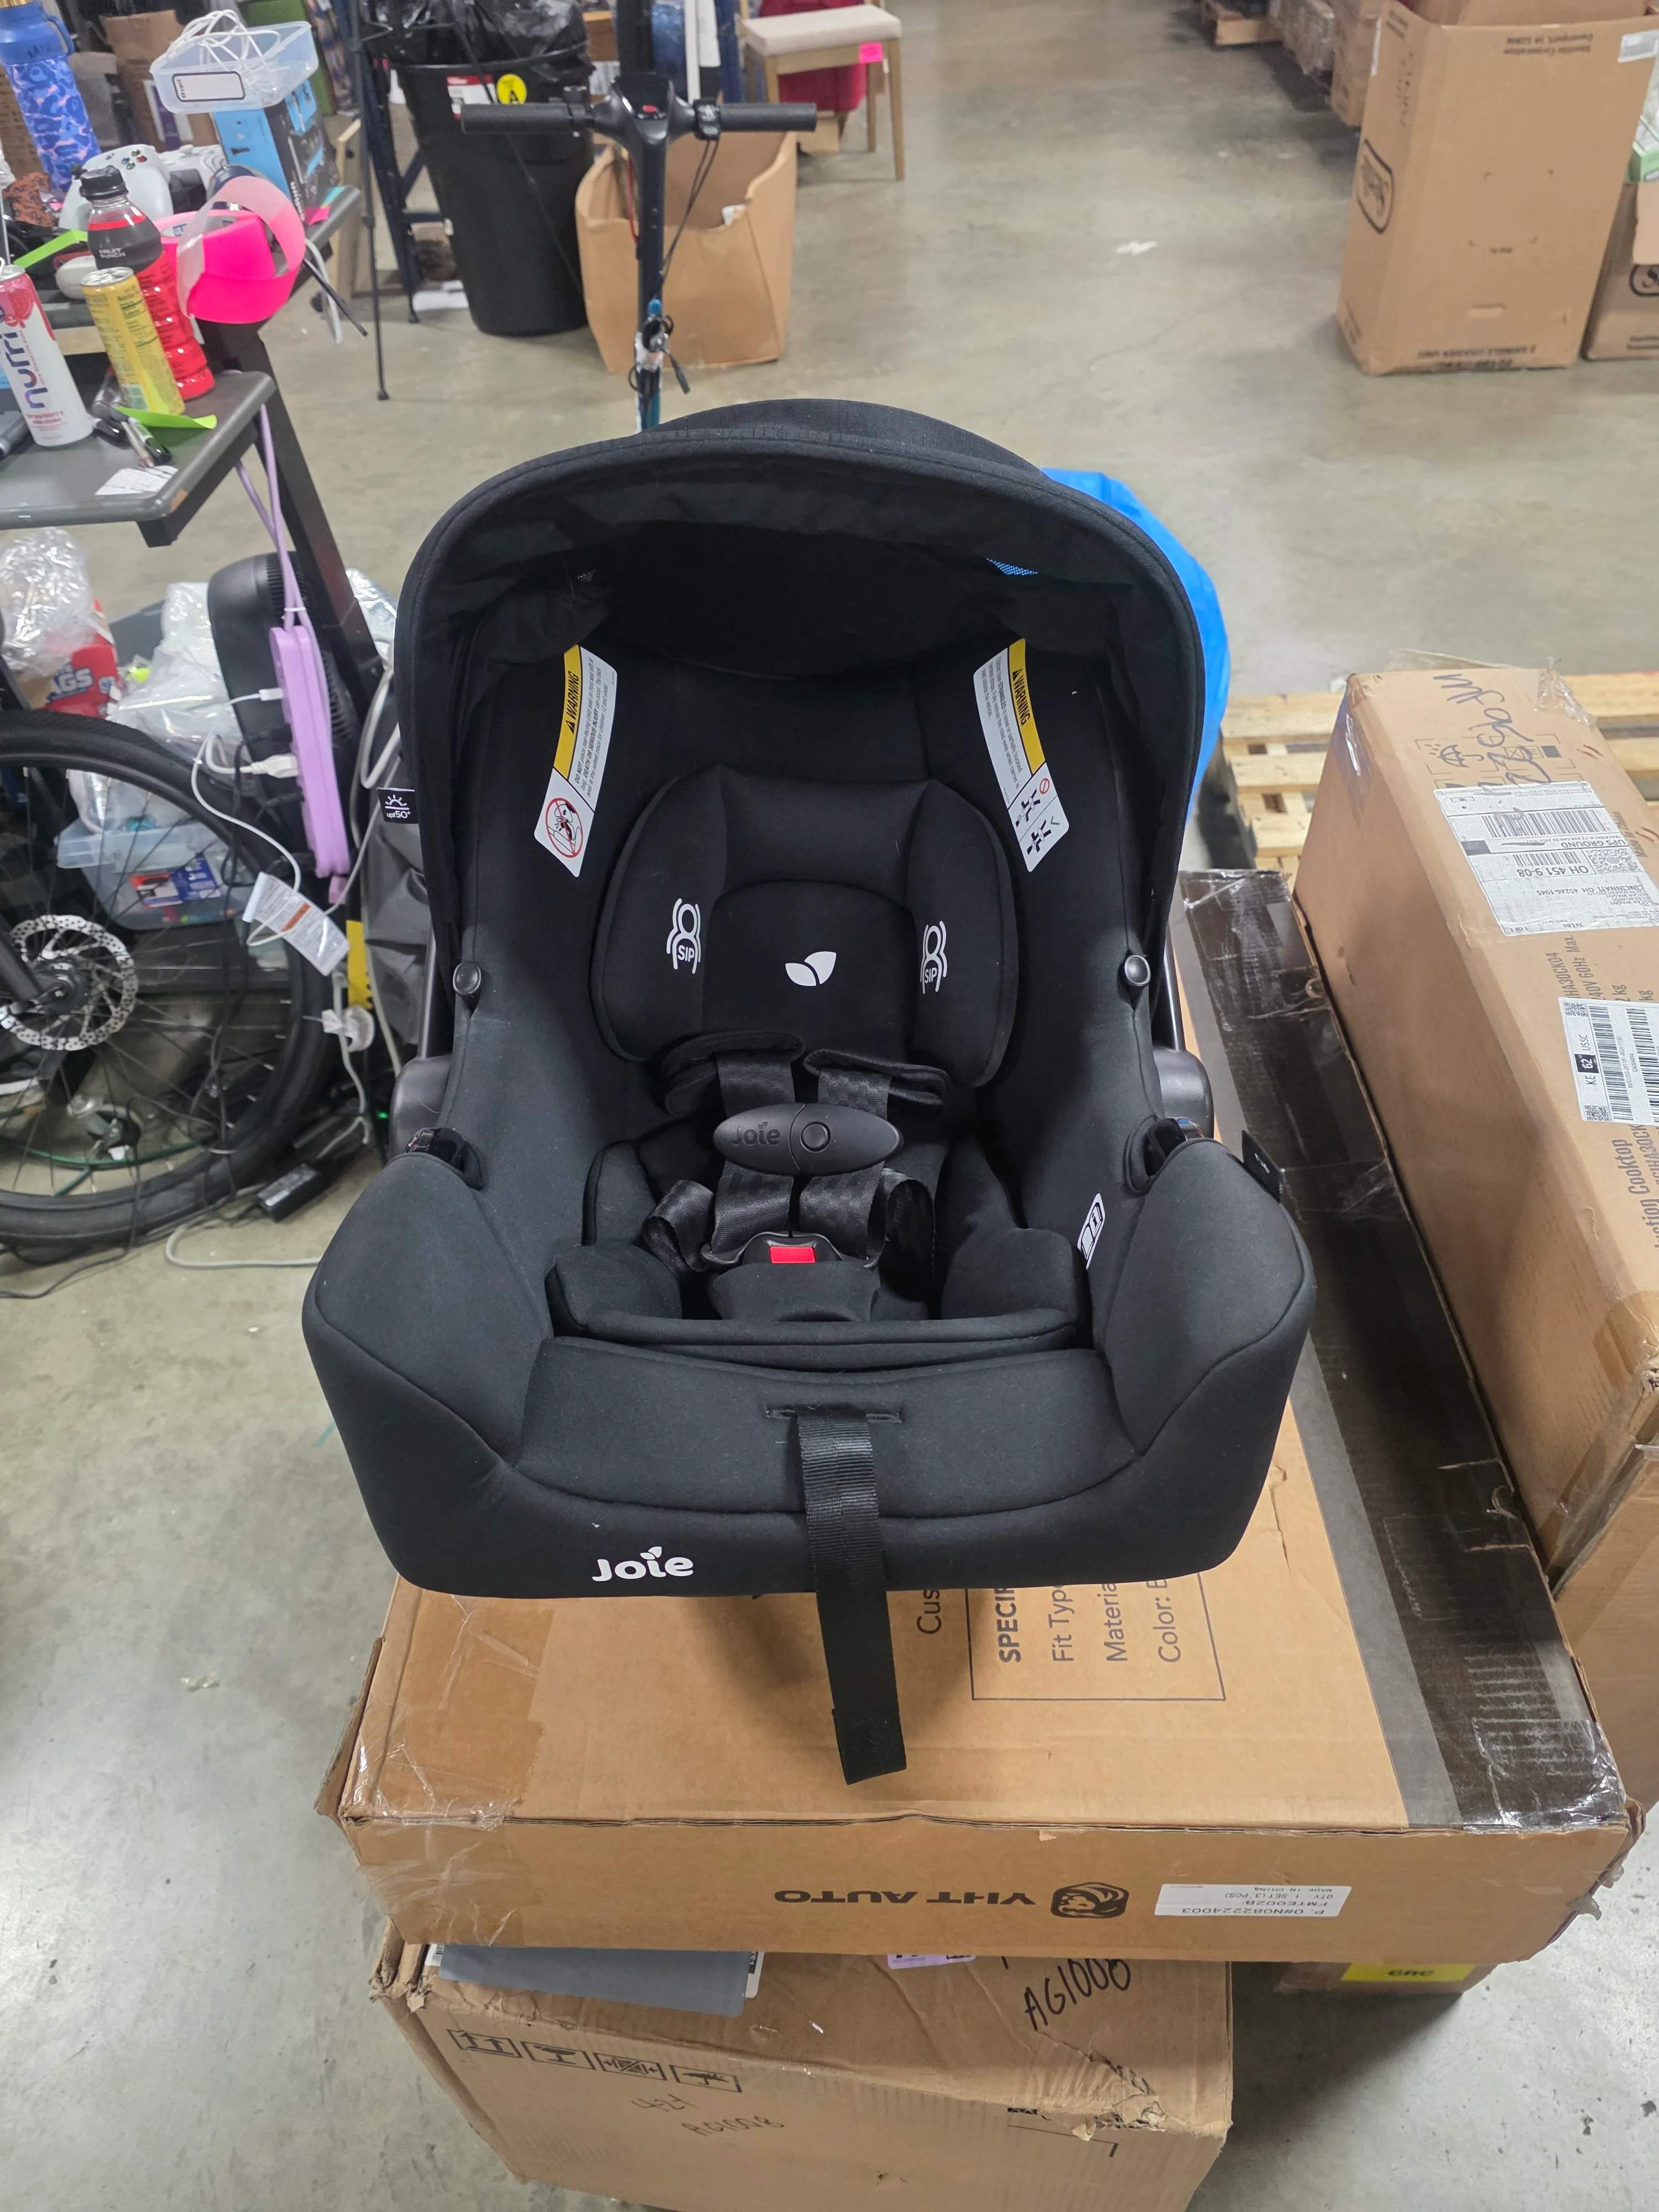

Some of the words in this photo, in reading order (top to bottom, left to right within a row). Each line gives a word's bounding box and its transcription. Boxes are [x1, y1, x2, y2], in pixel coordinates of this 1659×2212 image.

[0, 332, 48, 408] nurri
[566, 671, 578, 720] WARNING
[1014, 675, 1031, 725] WARNING
[587, 748, 592, 760] OR
[575, 774, 581, 784] DO
[1517, 868, 1543, 877] 9-08
[1568, 866, 1589, 874] OH
[1564, 935, 1581, 952] Max.
[677, 945, 695, 963] SIP
[924, 967, 937, 985] SIP
[1572, 957, 1594, 978] 60Hz
[1611, 984, 1627, 995] kg
[1638, 990, 1653, 1001] kg
[1579, 1034, 1590, 1051] USSC
[1582, 1058, 1593, 1069] 62
[1585, 1075, 1597, 1085] KE
[732, 1122, 780, 1146] Joie
[1611, 1139, 1650, 1194] Cooktop
[592, 1546, 694, 1582] Joie
[1047, 1585, 1075, 1628] Typ
[1152, 1597, 1181, 1662] Color:
[1052, 1634, 1074, 1661] Fit
[774, 1891, 919, 1903] AUTO
[926, 1891, 1036, 1905] VHT
